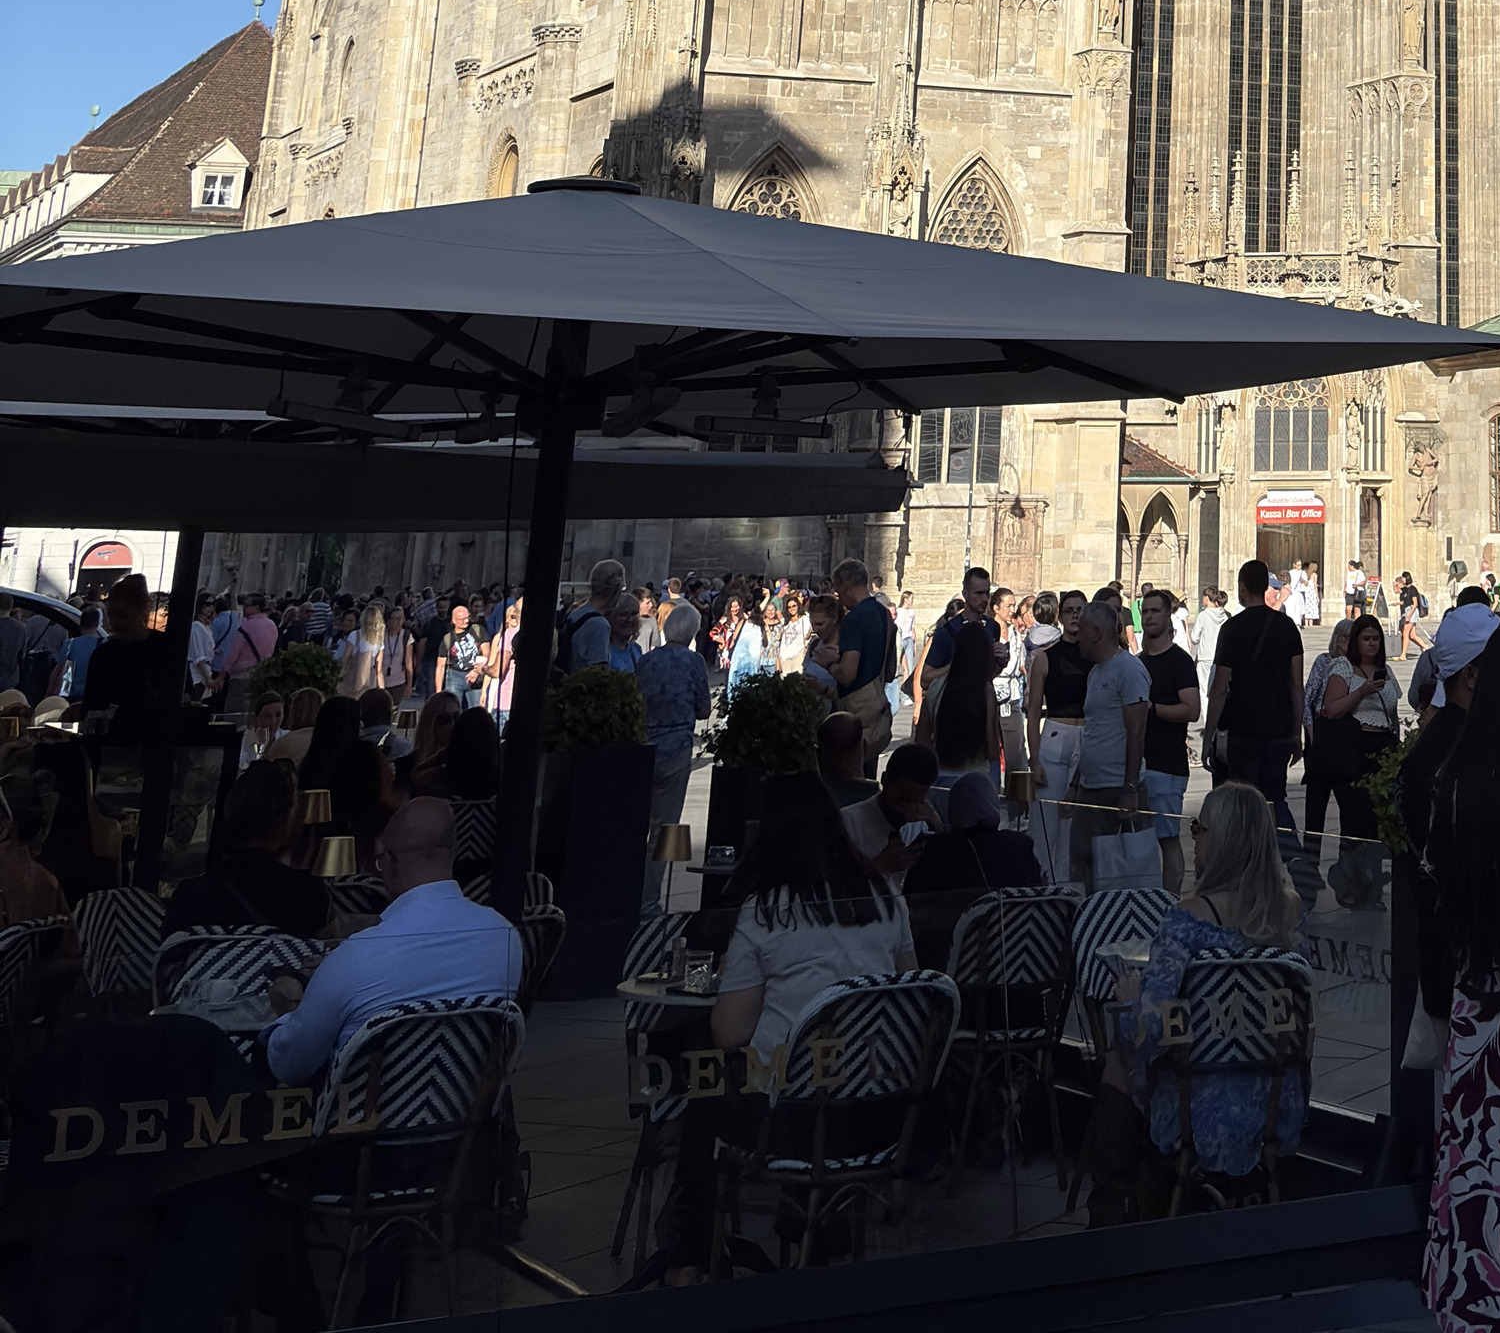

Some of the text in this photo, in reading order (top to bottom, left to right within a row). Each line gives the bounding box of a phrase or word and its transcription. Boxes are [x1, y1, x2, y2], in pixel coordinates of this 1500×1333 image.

[1260, 509, 1322, 518] Kassa Box Office
[43, 1081, 383, 1163] DEMEL
